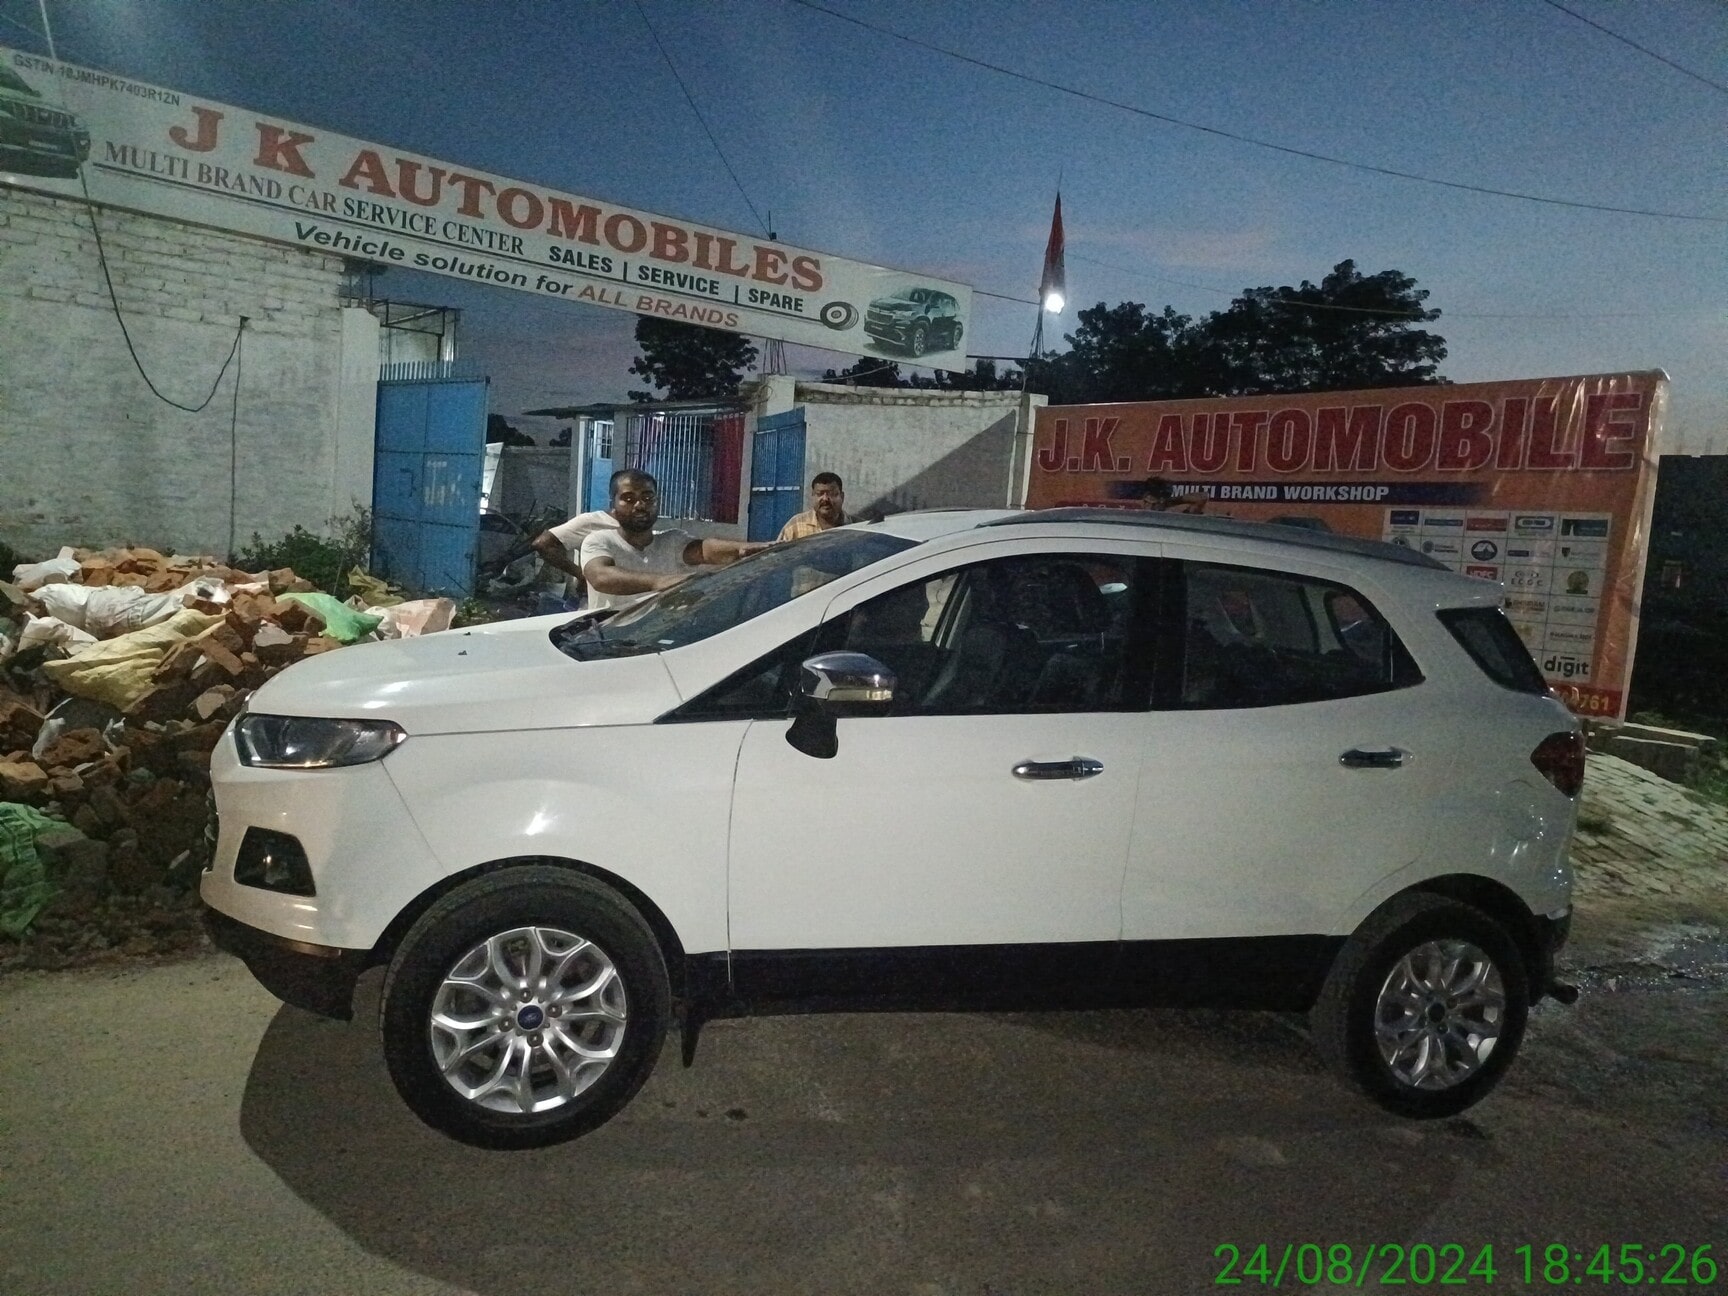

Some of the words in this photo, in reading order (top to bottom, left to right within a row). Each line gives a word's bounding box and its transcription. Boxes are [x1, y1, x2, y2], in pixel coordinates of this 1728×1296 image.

[14, 54, 54, 75] GSTIN
[105, 141, 188, 179] MULTI
[197, 163, 282, 200] BRAND
[288, 184, 337, 213] CAR
[344, 197, 436, 236] SERVICE
[443, 220, 524, 255] CENTER
[169, 106, 224, 153] J
[253, 122, 316, 178] K
[339, 149, 823, 292] AUTOMOBILES
[295, 221, 405, 260] Vehicle
[414, 249, 527, 287] solution
[536, 275, 574, 296] for
[578, 284, 628, 307] ALL
[636, 297, 739, 328] BRANDS
[549, 245, 613, 273] SALES
[638, 265, 719, 296] SERVICE
[748, 288, 804, 313] SPARE
[1038, 417, 1131, 473] J.K.
[1146, 392, 1643, 474] AUTOMOBILE
[1220, 485, 1278, 500] BRAND
[1284, 486, 1389, 501] WORKSHOP
[1544, 656, 1589, 677] digit
